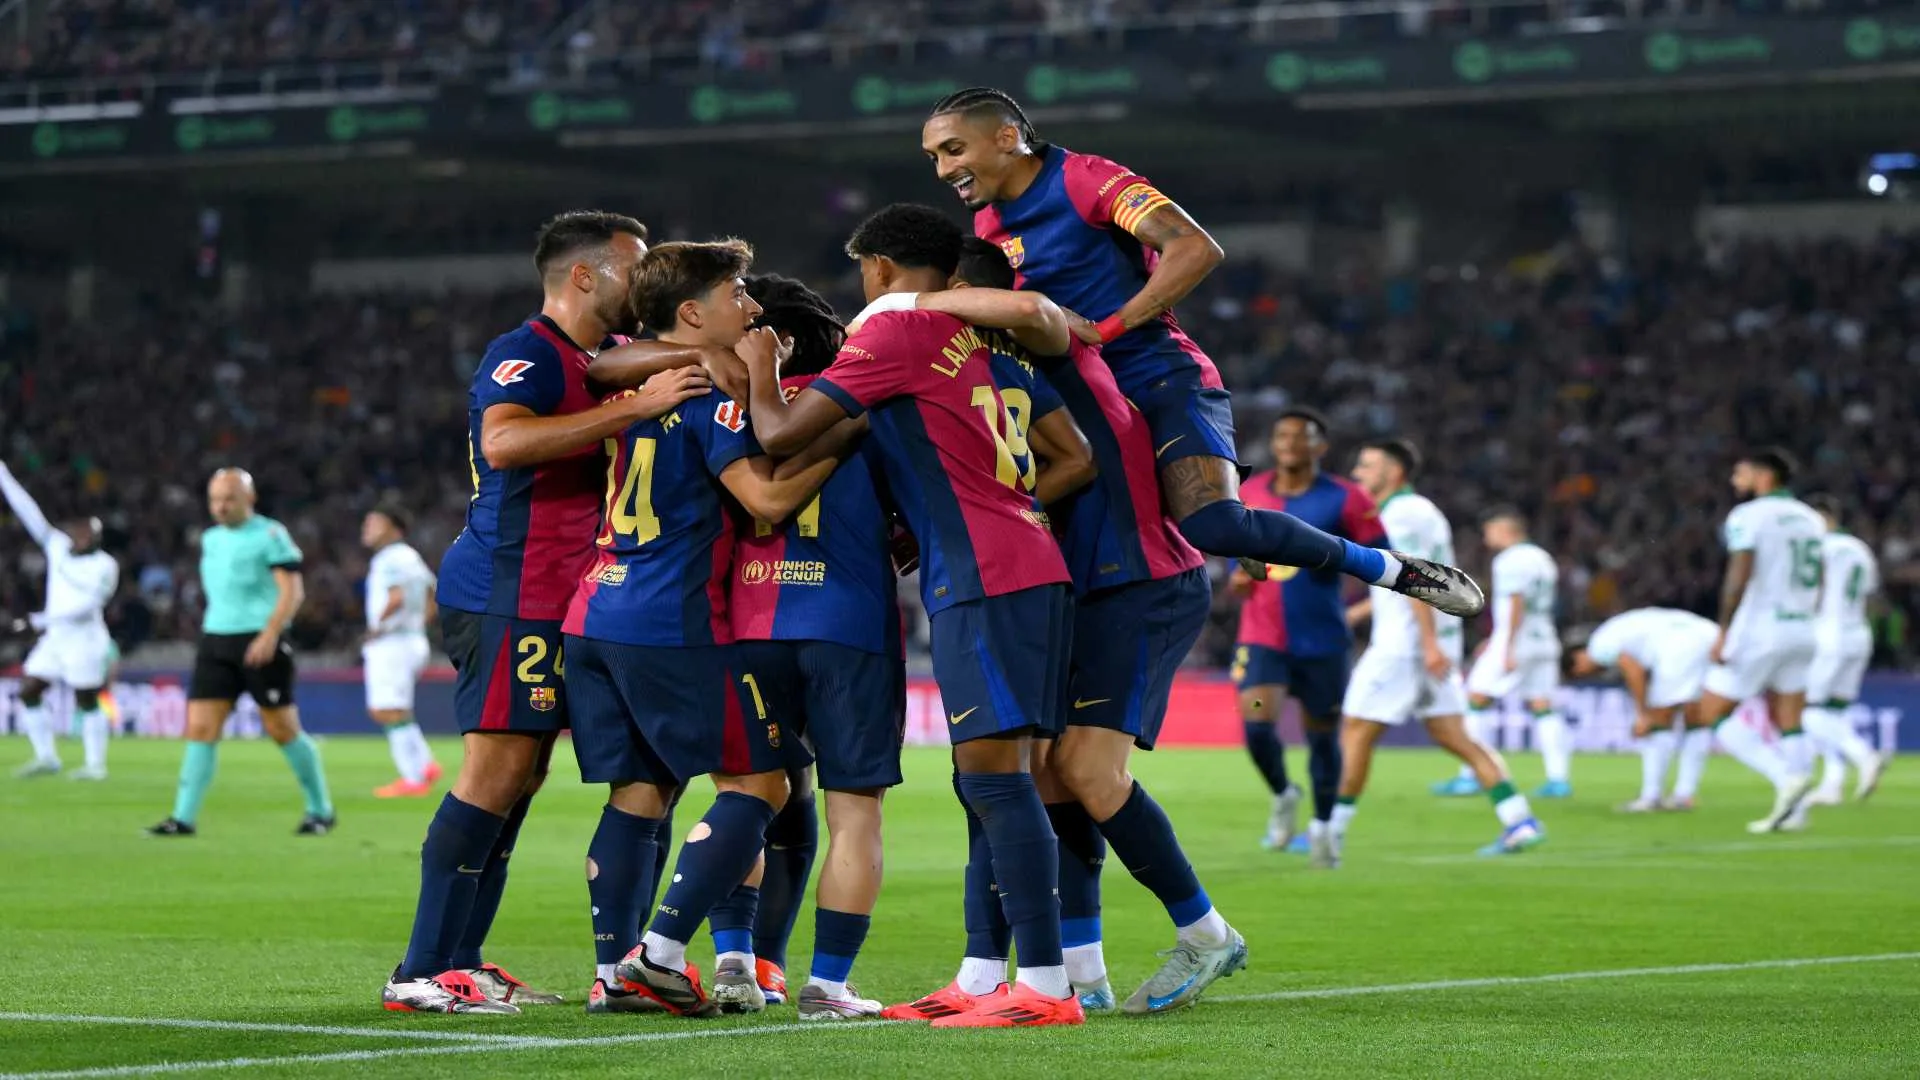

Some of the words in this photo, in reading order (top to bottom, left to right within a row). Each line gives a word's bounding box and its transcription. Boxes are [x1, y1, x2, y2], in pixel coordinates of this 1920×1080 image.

[971, 385, 1037, 492] 19
[604, 437, 661, 546] 14
[773, 561, 826, 571] UNHCR
[773, 570, 824, 581] ACNUR
[1788, 537, 1823, 589] 15
